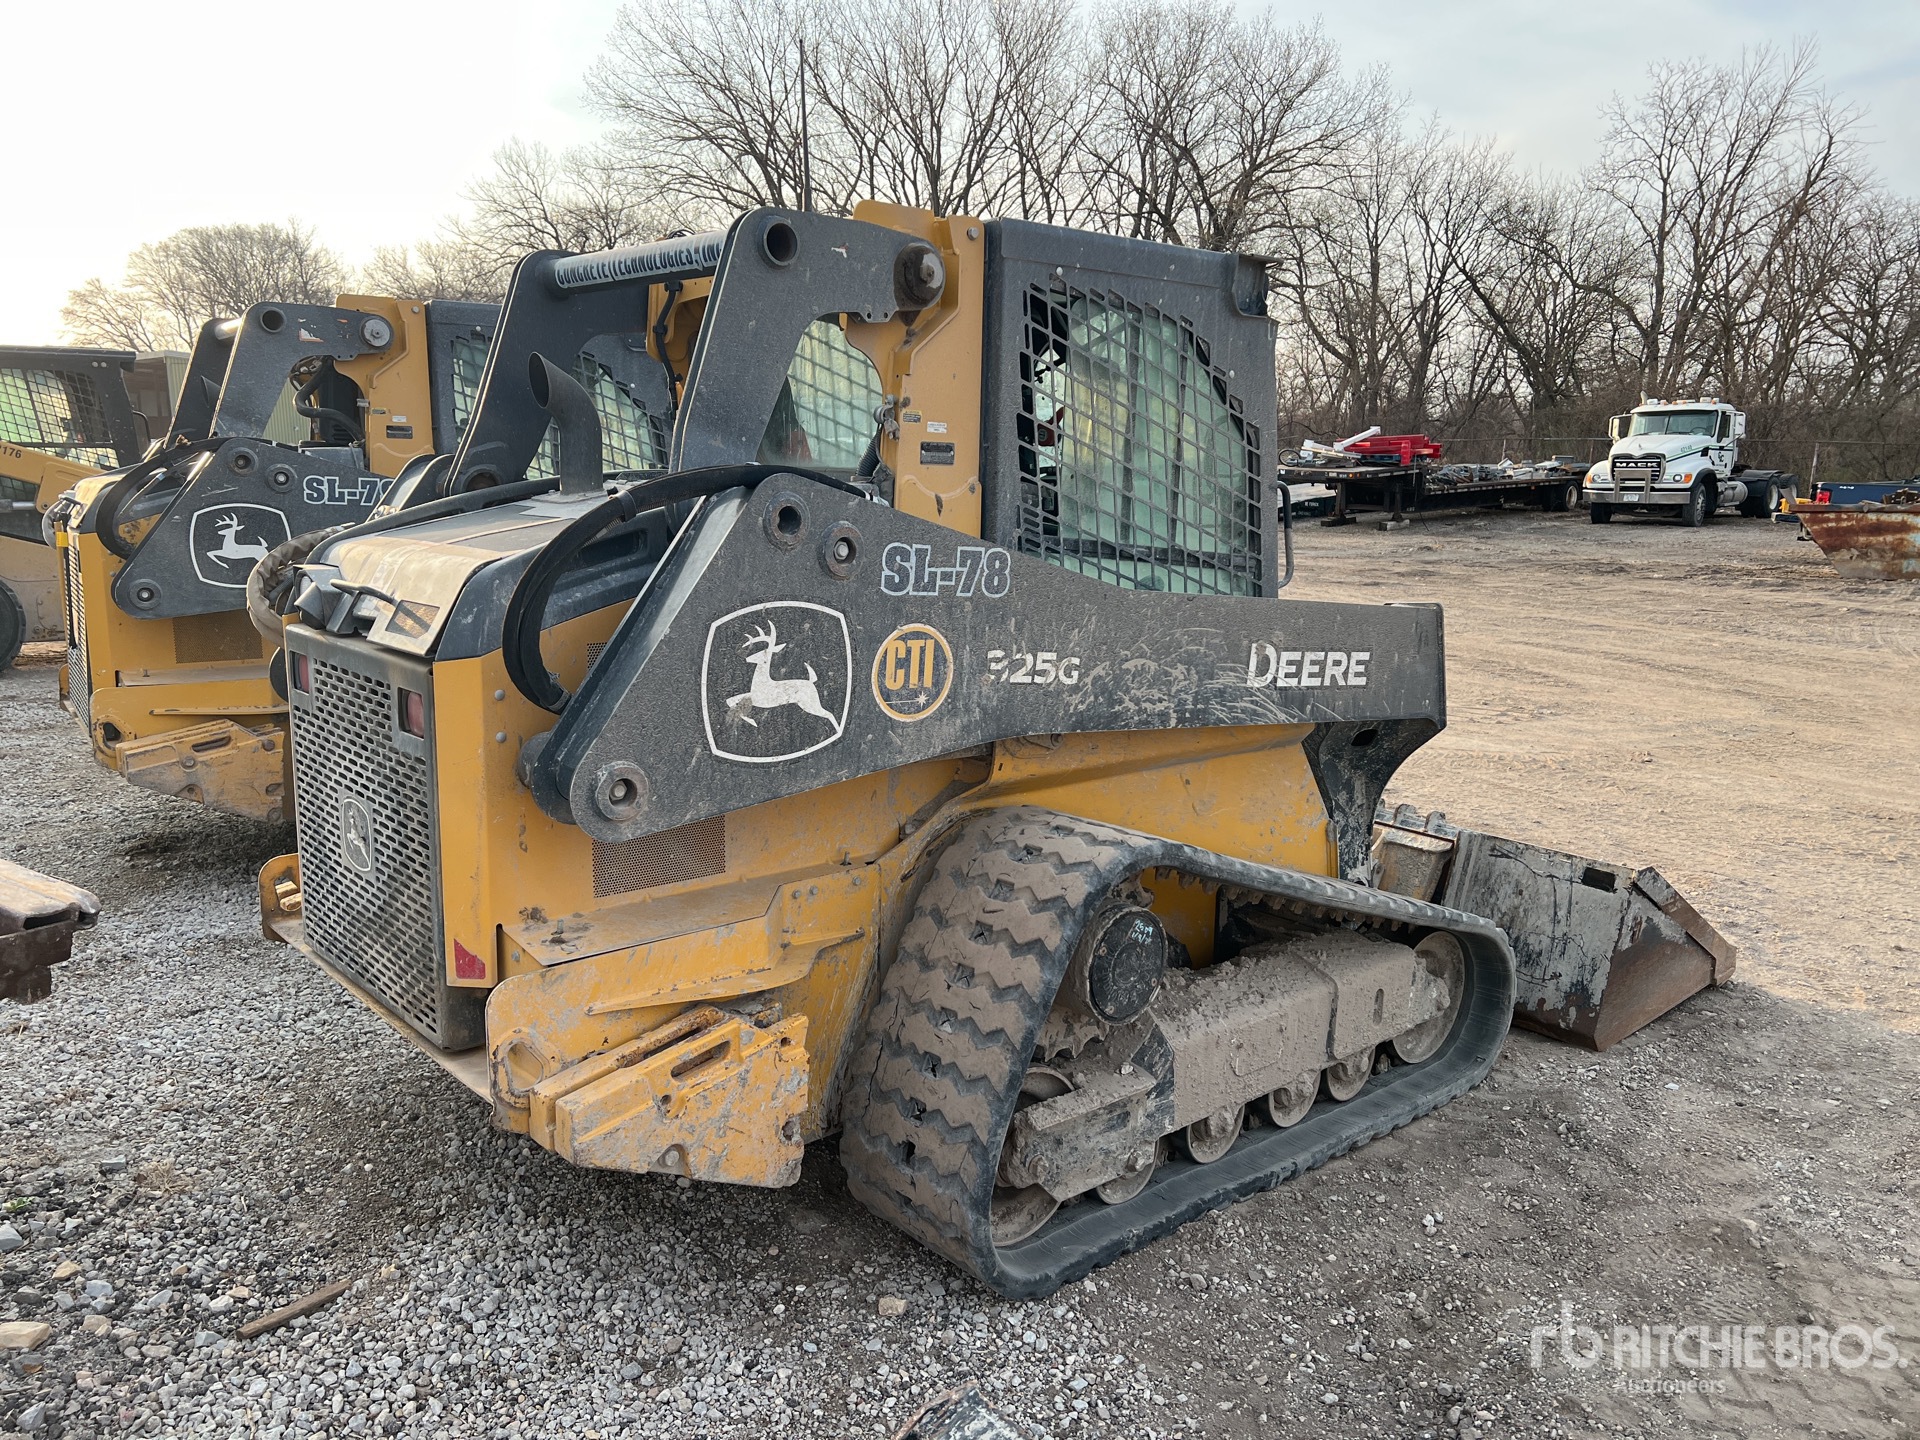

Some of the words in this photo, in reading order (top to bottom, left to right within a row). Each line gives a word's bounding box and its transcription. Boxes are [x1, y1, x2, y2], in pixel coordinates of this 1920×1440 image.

[0, 445, 22, 459] 176
[881, 542, 1011, 598] SL-78
[885, 639, 935, 691] CTI
[1246, 643, 1371, 688] DEERE
